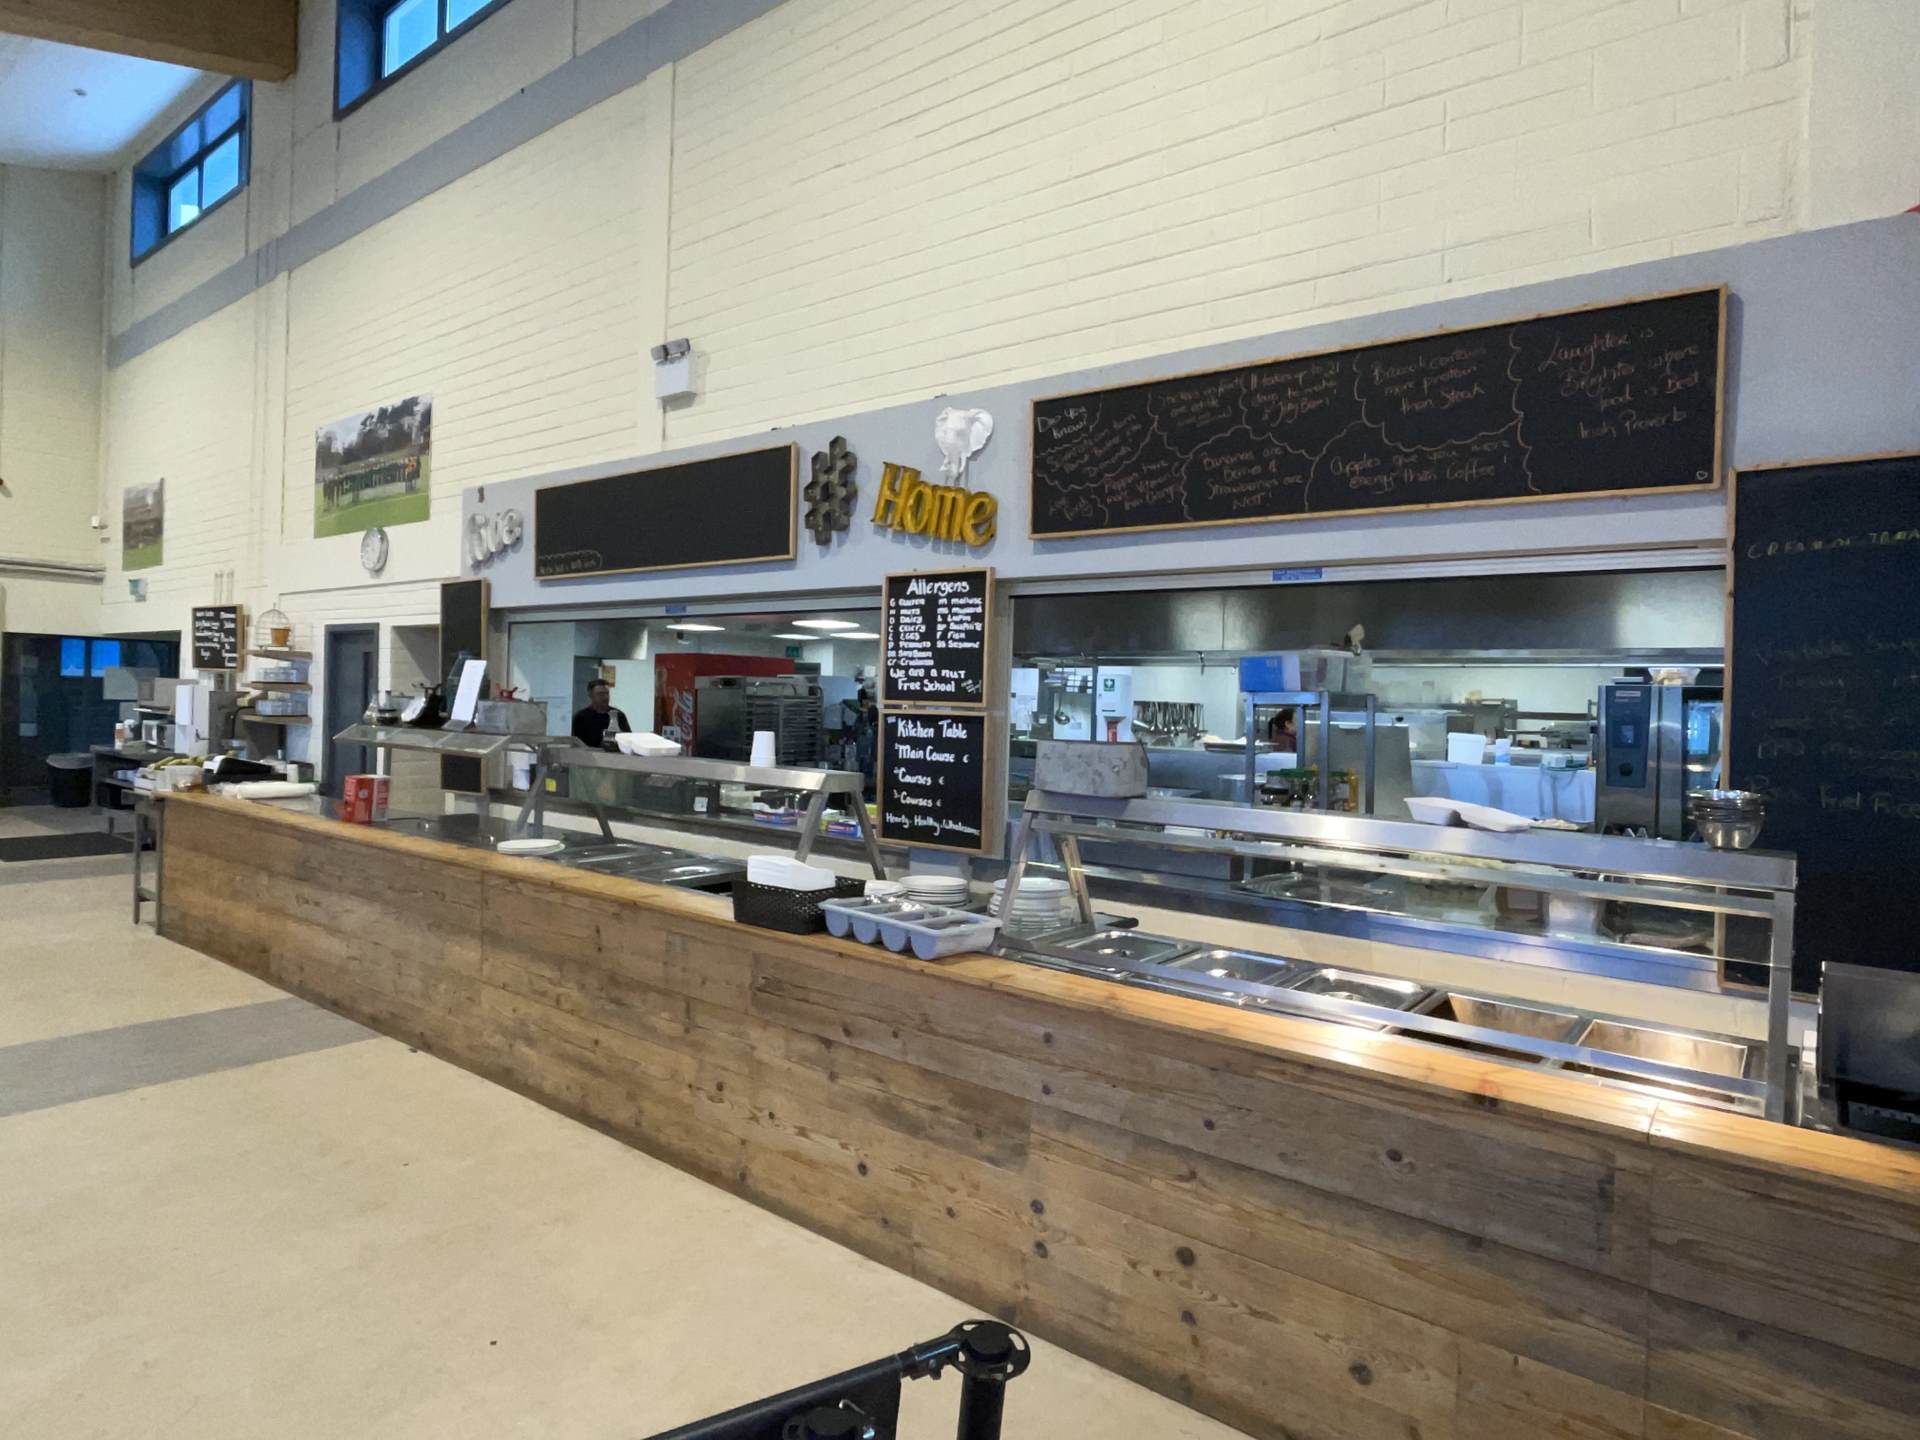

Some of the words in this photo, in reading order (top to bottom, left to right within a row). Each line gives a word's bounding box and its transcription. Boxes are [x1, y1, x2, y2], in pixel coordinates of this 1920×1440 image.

[1538, 333, 1632, 374] Laughter
[870, 462, 999, 547] Home
[906, 578, 969, 597] Allergens
[889, 668, 906, 678] We
[898, 677, 921, 691] Free
[923, 678, 956, 692] School
[897, 717, 934, 738] Kitchen
[938, 719, 968, 739] Table
[926, 745, 955, 763] Course
